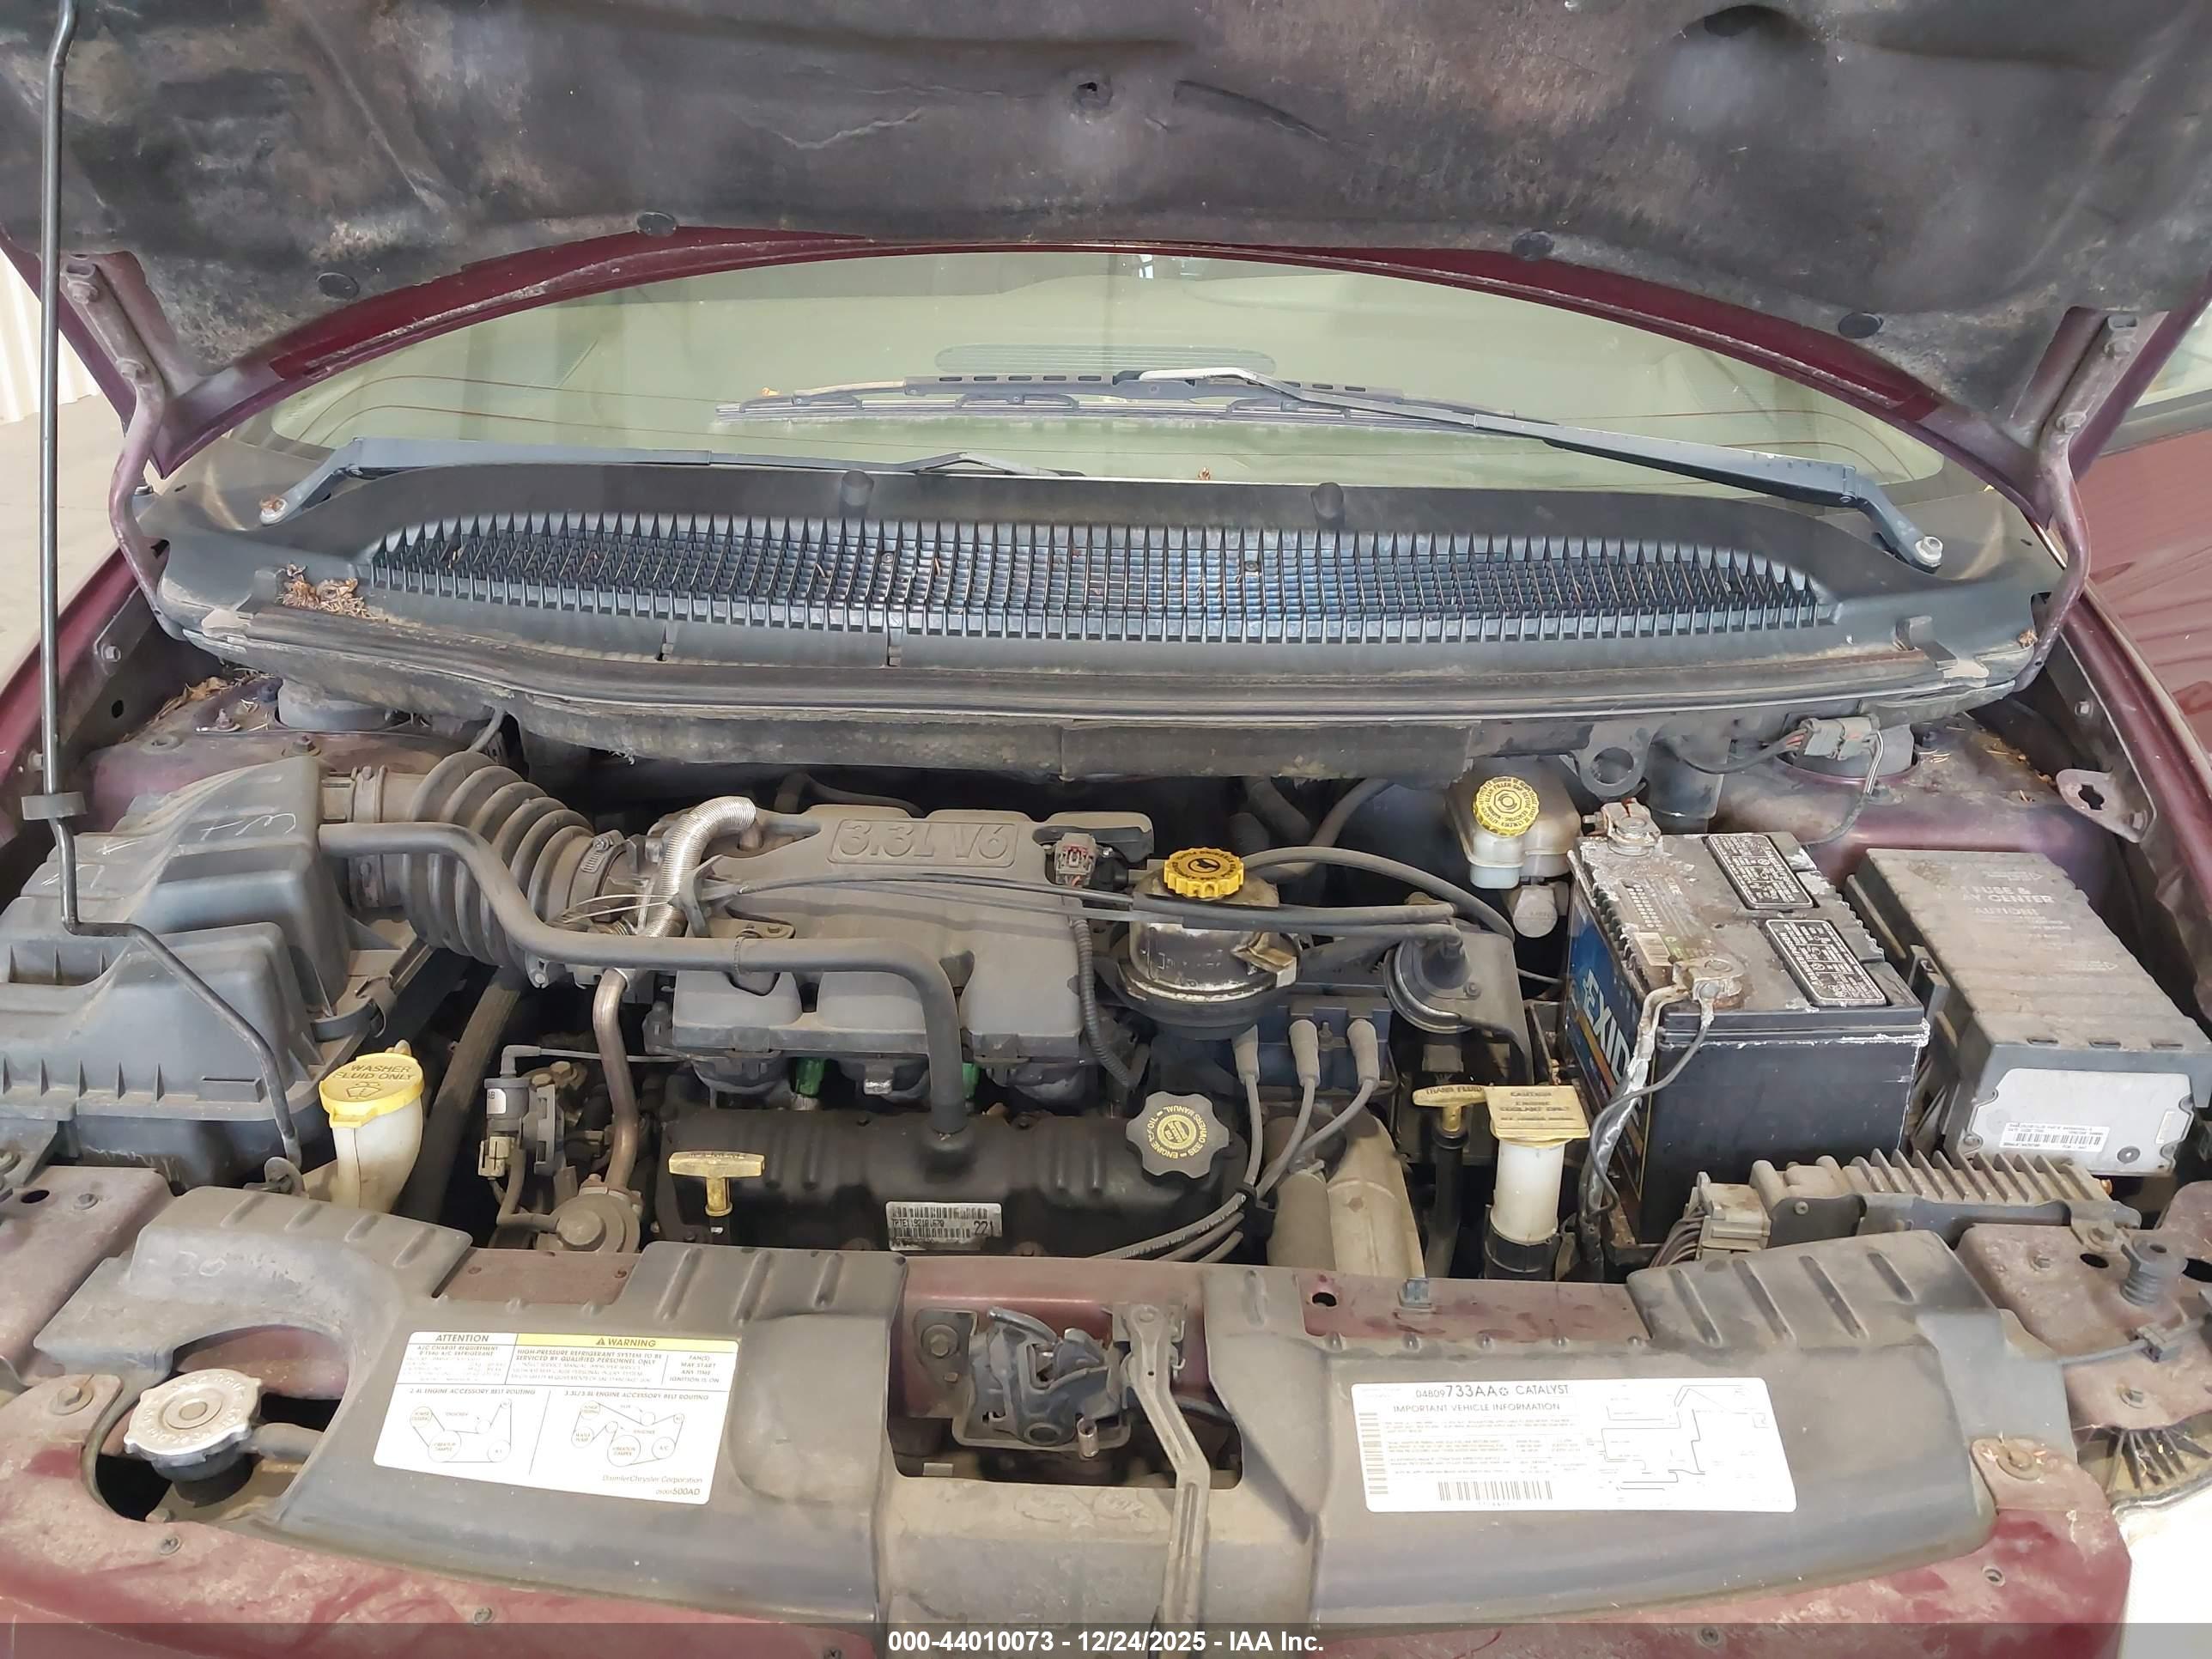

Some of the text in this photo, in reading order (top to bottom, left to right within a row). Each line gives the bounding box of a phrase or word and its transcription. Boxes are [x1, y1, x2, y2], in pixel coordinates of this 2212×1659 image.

[840, 823, 1010, 860] 3.3L V6
[1583, 969, 1631, 1085] EXID
[1147, 1116, 1159, 1129] OIL
[608, 1338, 657, 1347] WARNING
[1516, 1384, 1569, 1395] CATALYST
[1393, 1402, 1560, 1413] IMPORTANT VEHICLE INFORMATION
[661, 1475, 703, 1484] Corporation
